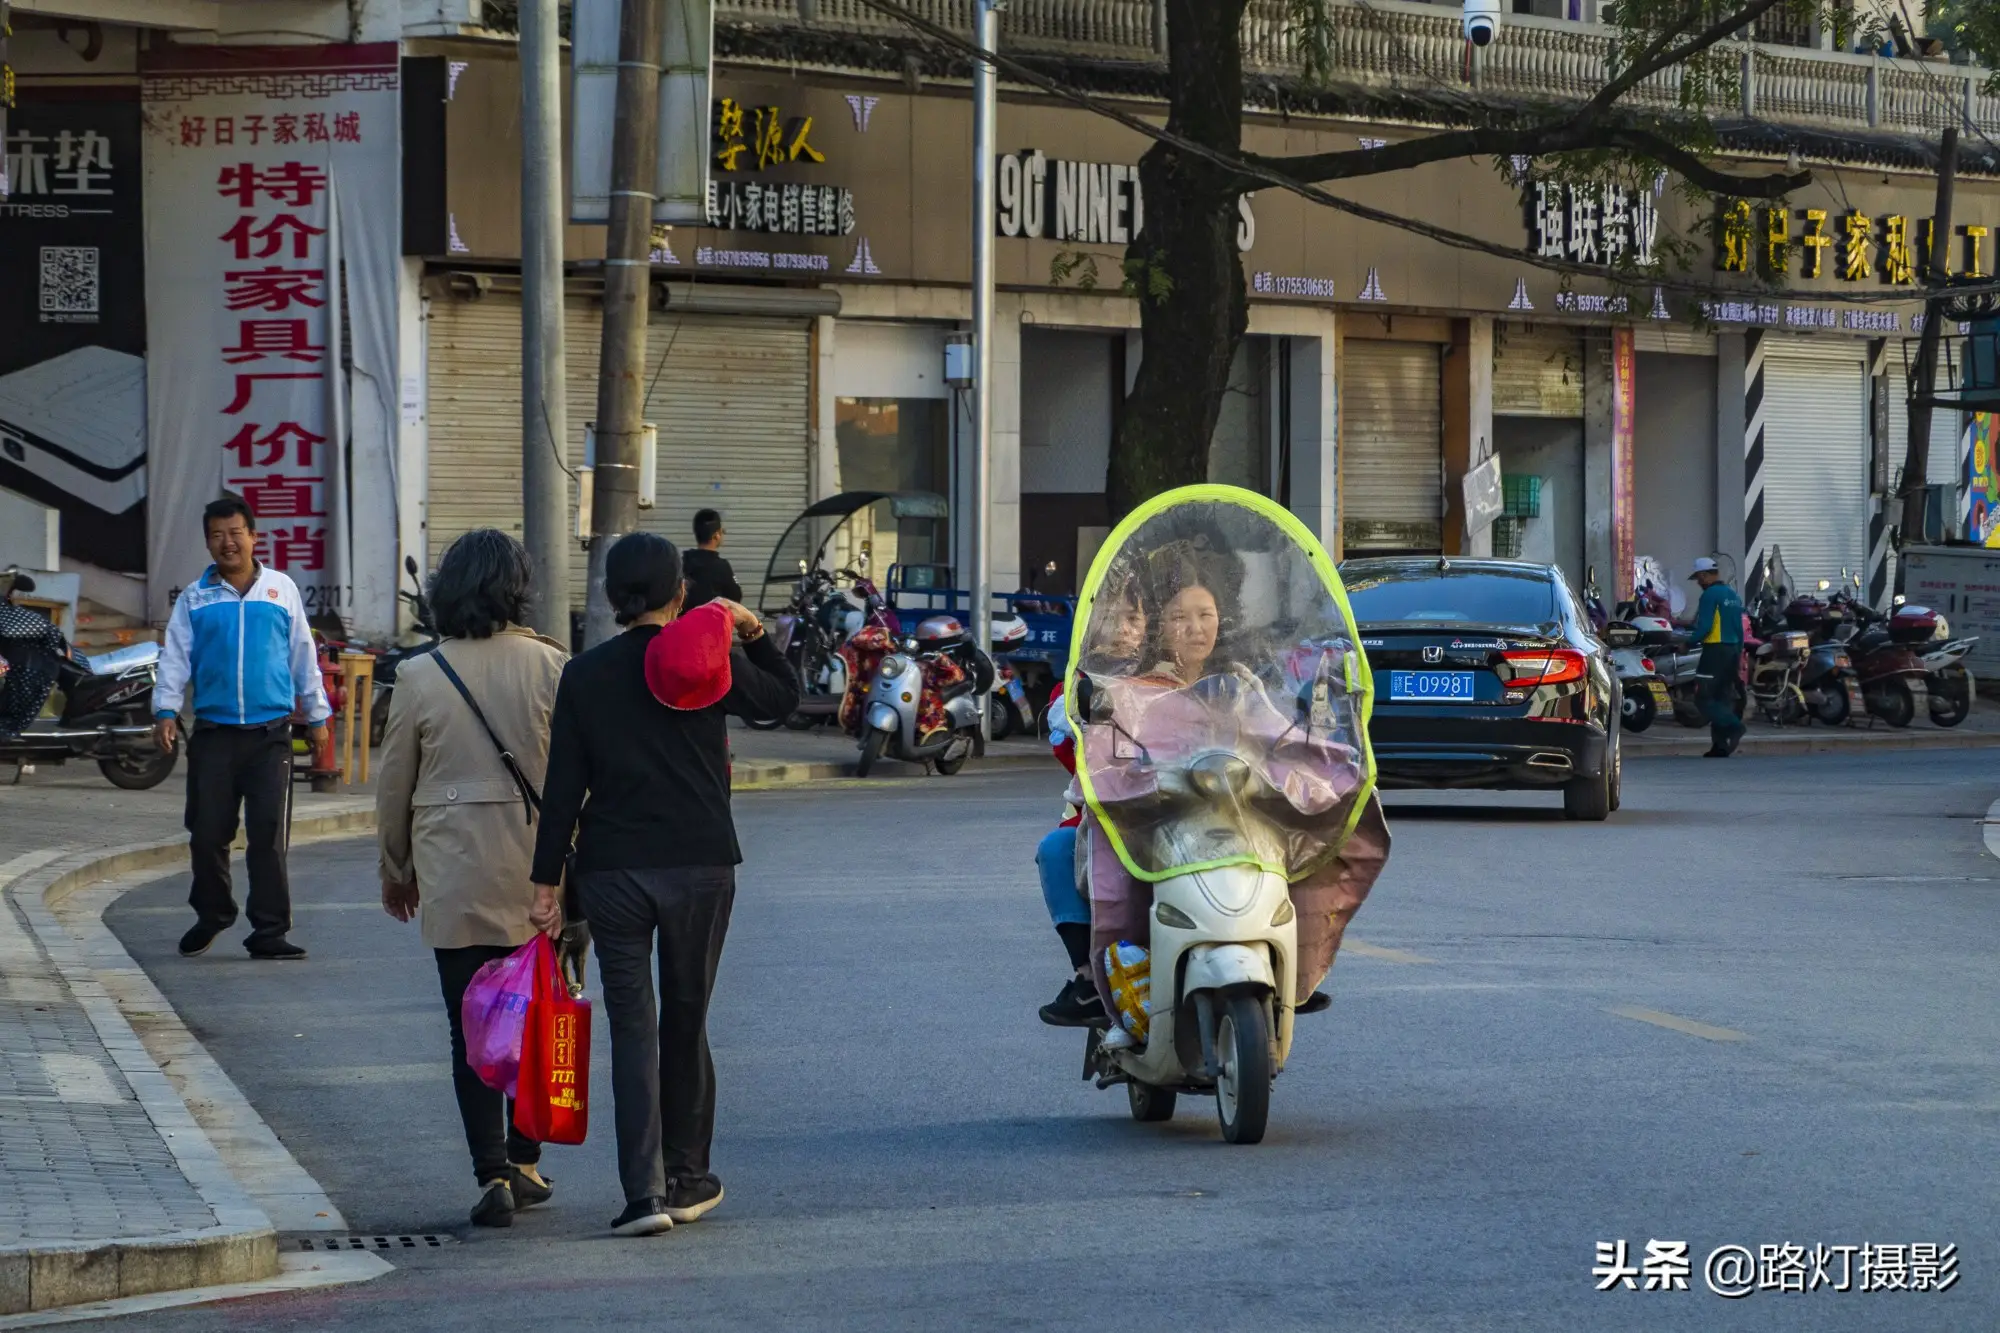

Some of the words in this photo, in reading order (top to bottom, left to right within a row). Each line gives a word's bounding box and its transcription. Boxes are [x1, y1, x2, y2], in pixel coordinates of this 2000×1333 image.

[8, 130, 114, 196] 床垫
[180, 111, 362, 147] 好日子家私城
[1536, 181, 1659, 265] 强联鞋业
[217, 162, 327, 571] 特价家具厂价直销
